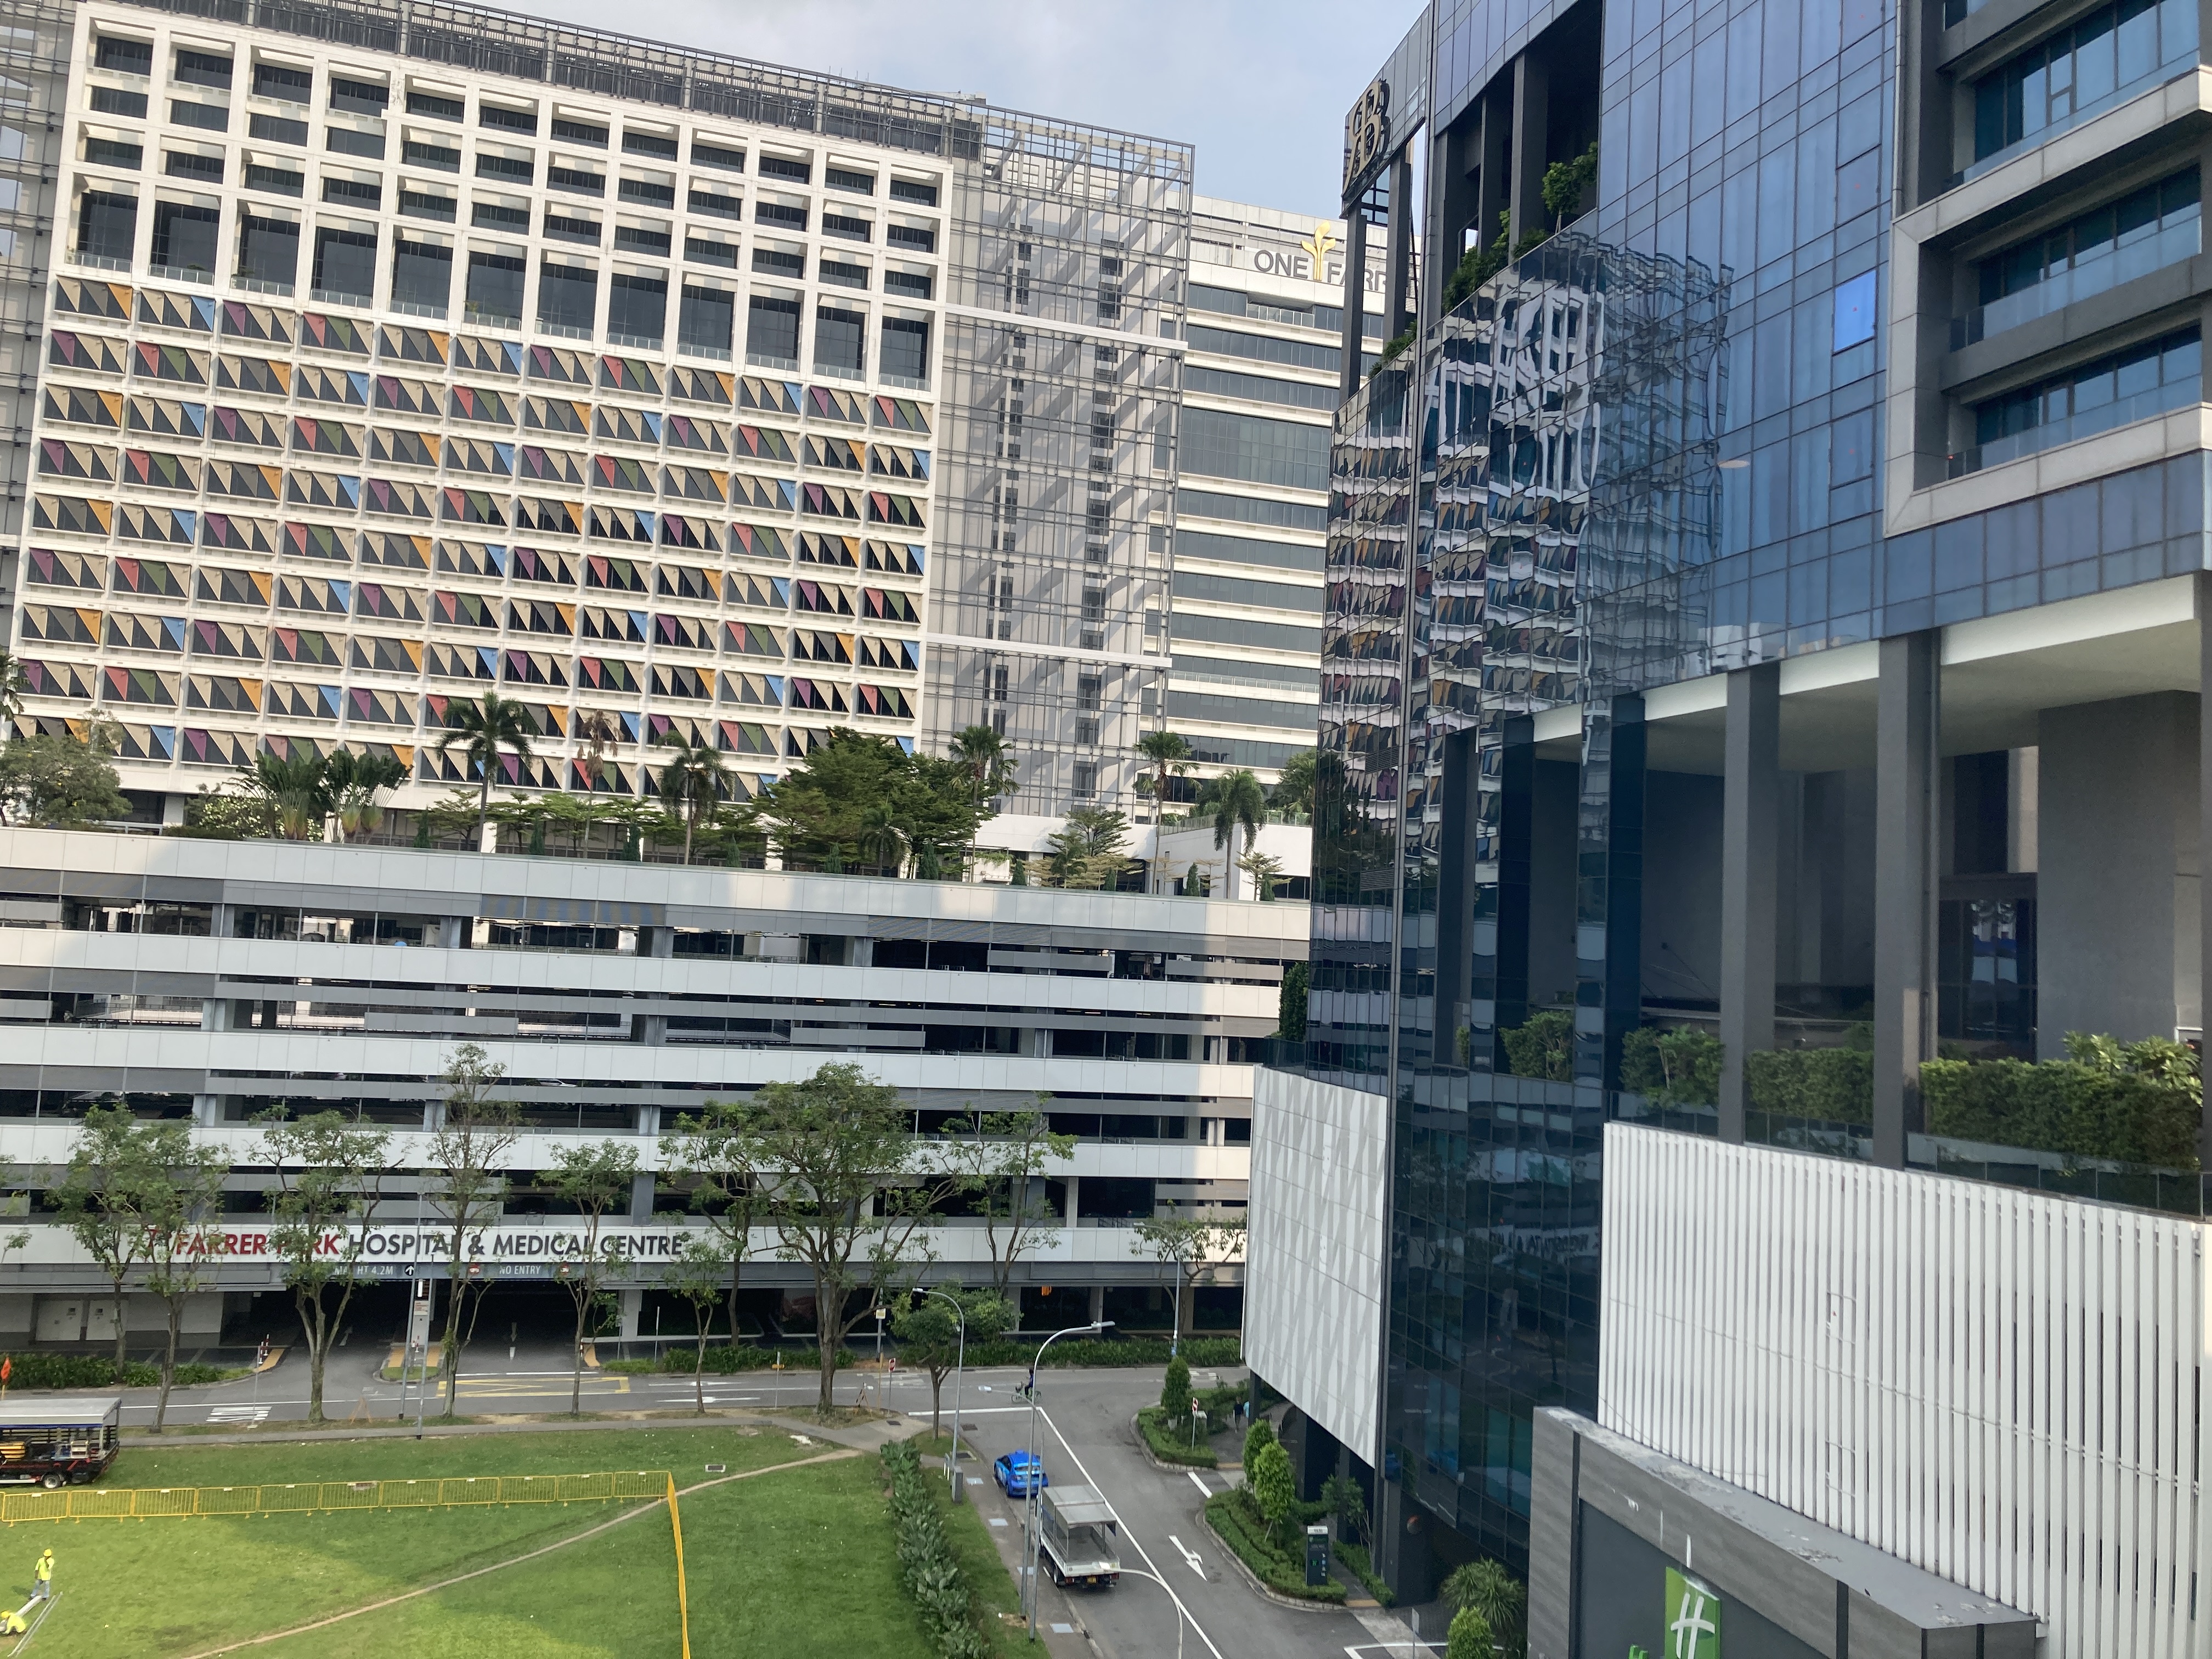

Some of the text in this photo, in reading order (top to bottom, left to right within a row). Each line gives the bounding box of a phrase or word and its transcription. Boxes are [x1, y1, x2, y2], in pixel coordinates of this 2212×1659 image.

[1254, 250, 1308, 279] ONE
[176, 1233, 267, 1255] FARRER
[276, 1234, 340, 1255] PRK
[468, 1234, 486, 1255] &
[493, 1234, 591, 1255] MEDICAL
[600, 1235, 682, 1255] CENTRE
[357, 1266, 369, 1275] HT
[371, 1266, 393, 1276] 4.2M
[499, 1265, 541, 1275] NO ENTRY
